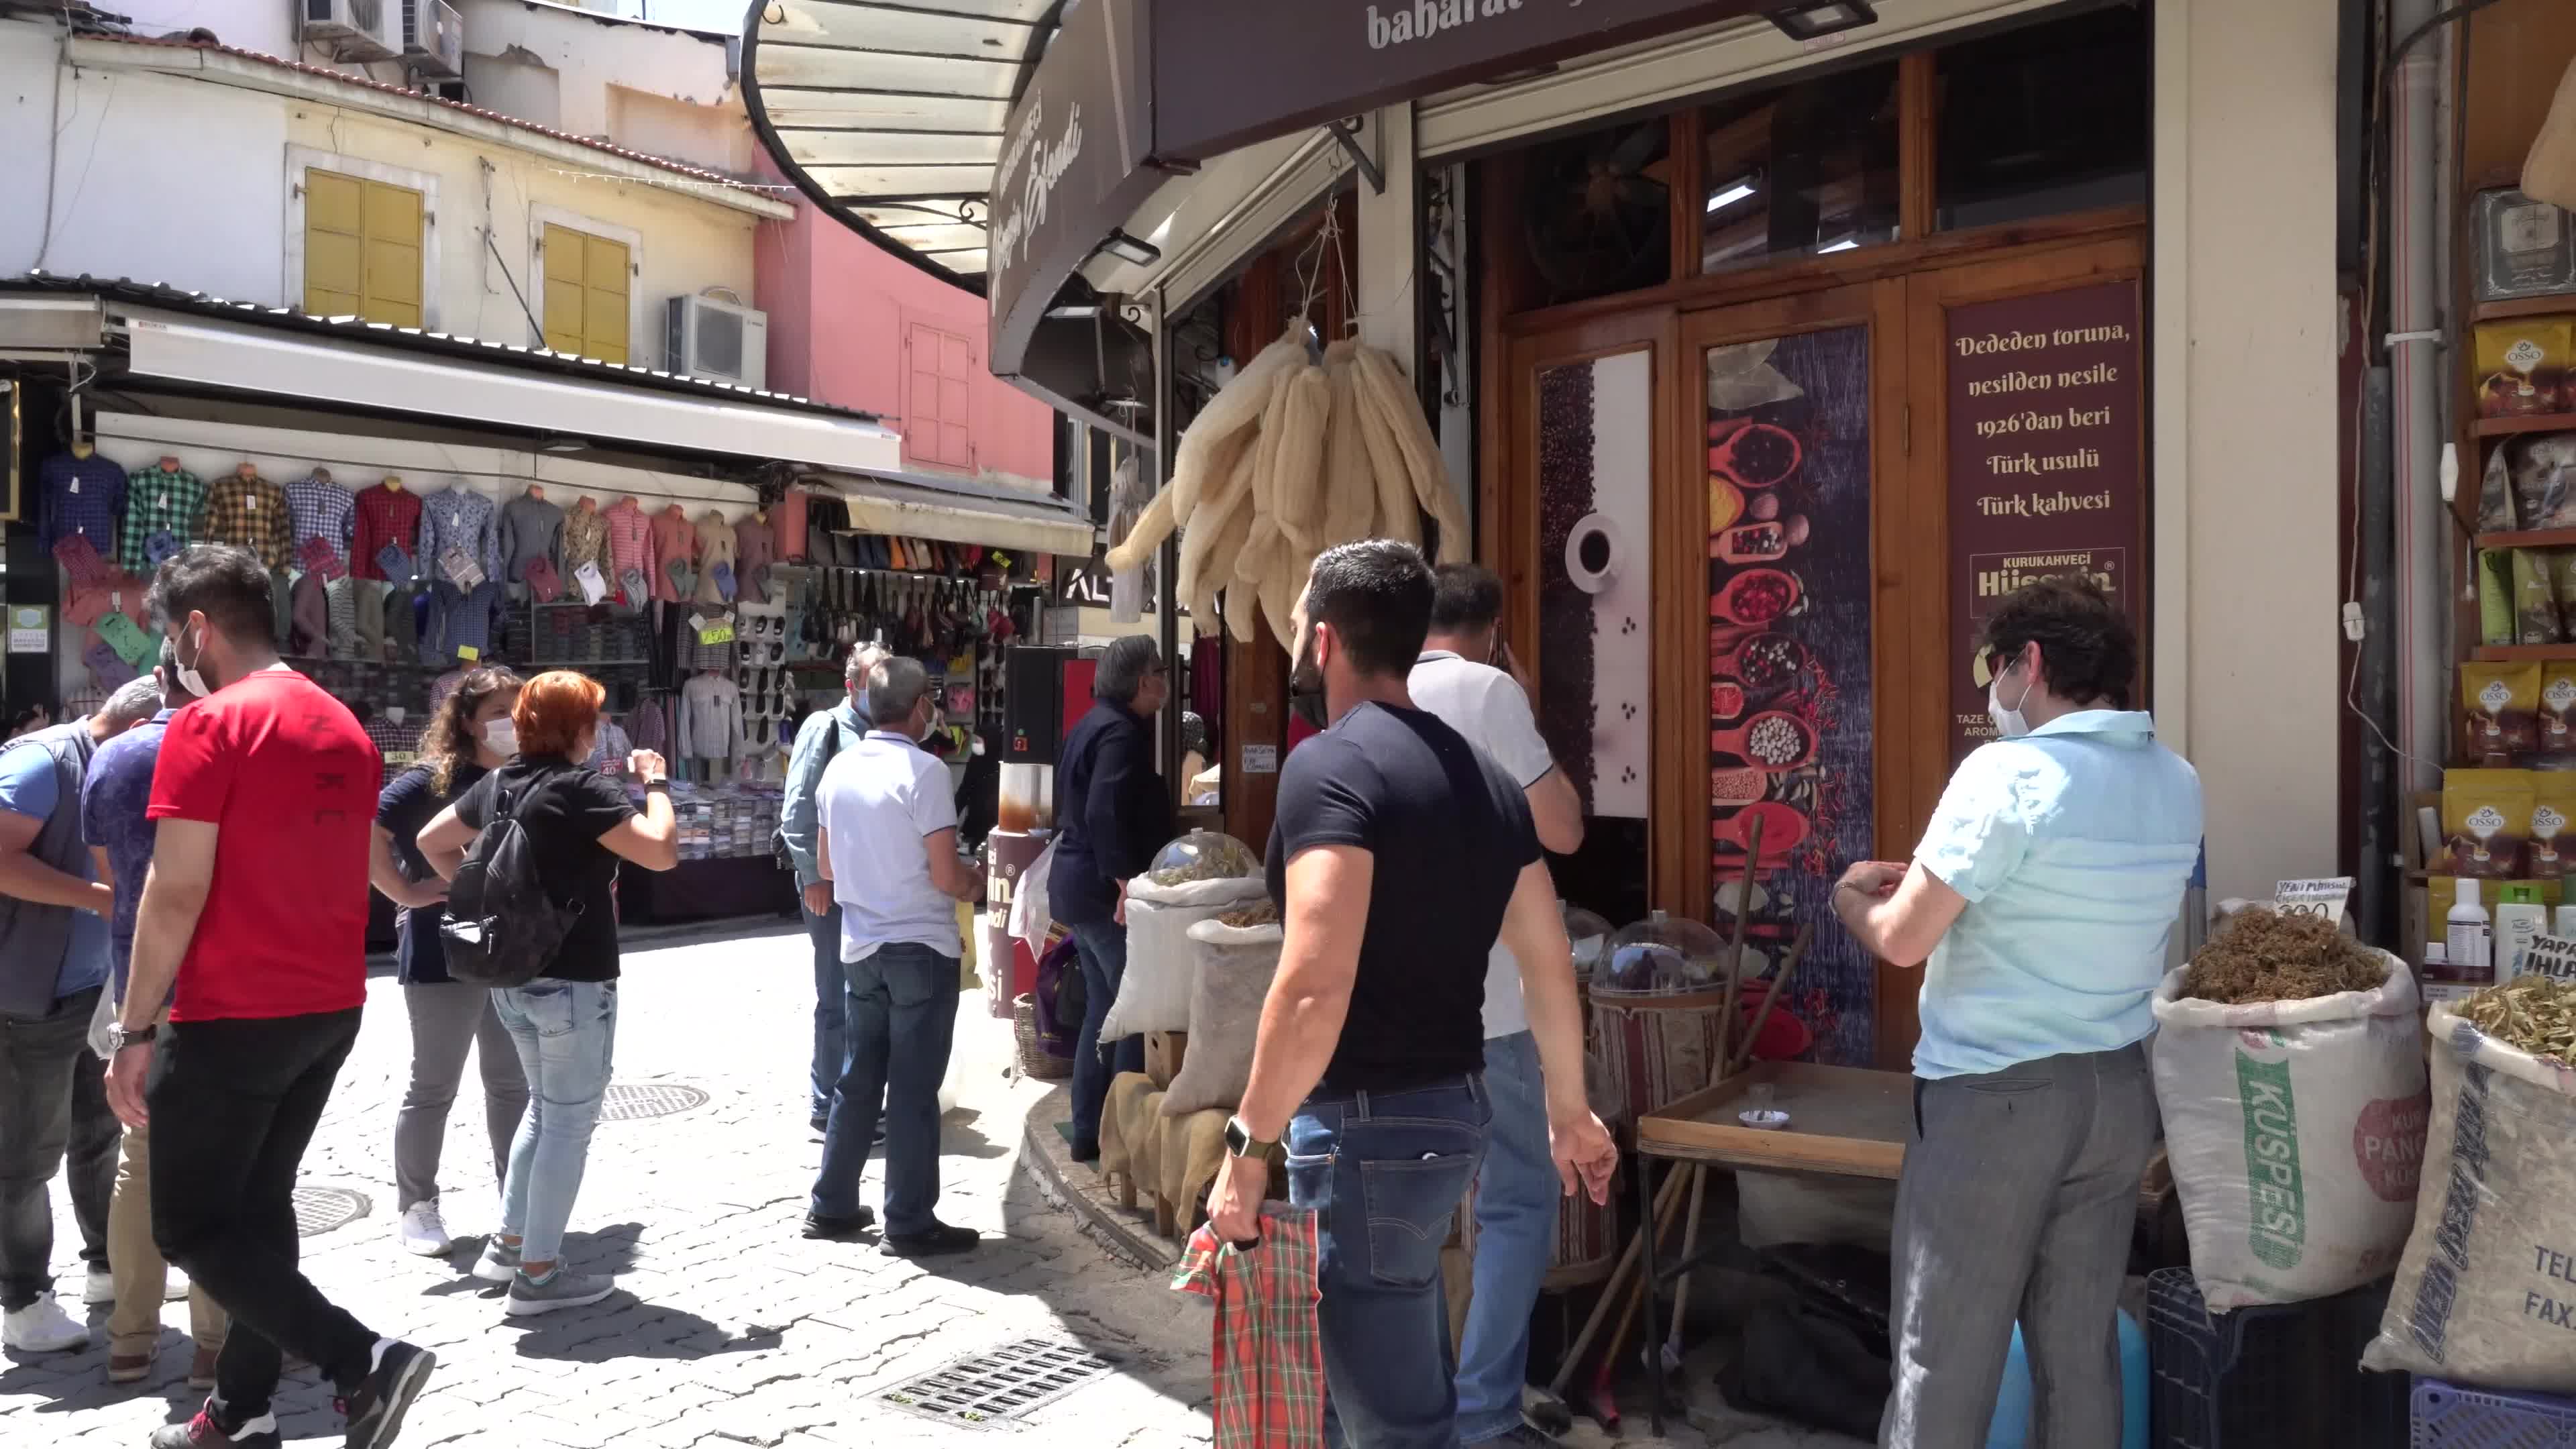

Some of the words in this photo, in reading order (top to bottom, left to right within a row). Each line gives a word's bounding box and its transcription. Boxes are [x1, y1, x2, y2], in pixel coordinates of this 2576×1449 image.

[1955, 331, 2047, 356] Dededen
[2053, 325, 2130, 345] toruna,
[1968, 371, 2051, 396] nesilden
[2057, 362, 2118, 387] nesile
[1976, 411, 2063, 439] 1926'dan
[2068, 406, 2110, 427] beri
[1986, 453, 2042, 475] Türk
[2042, 448, 2099, 470] usulü
[1976, 494, 2033, 517] Türk
[2032, 490, 2110, 516] kahvesi
[2003, 551, 2091, 568] KURUKAHVECİ
[1956, 714, 1984, 724] TAZE
